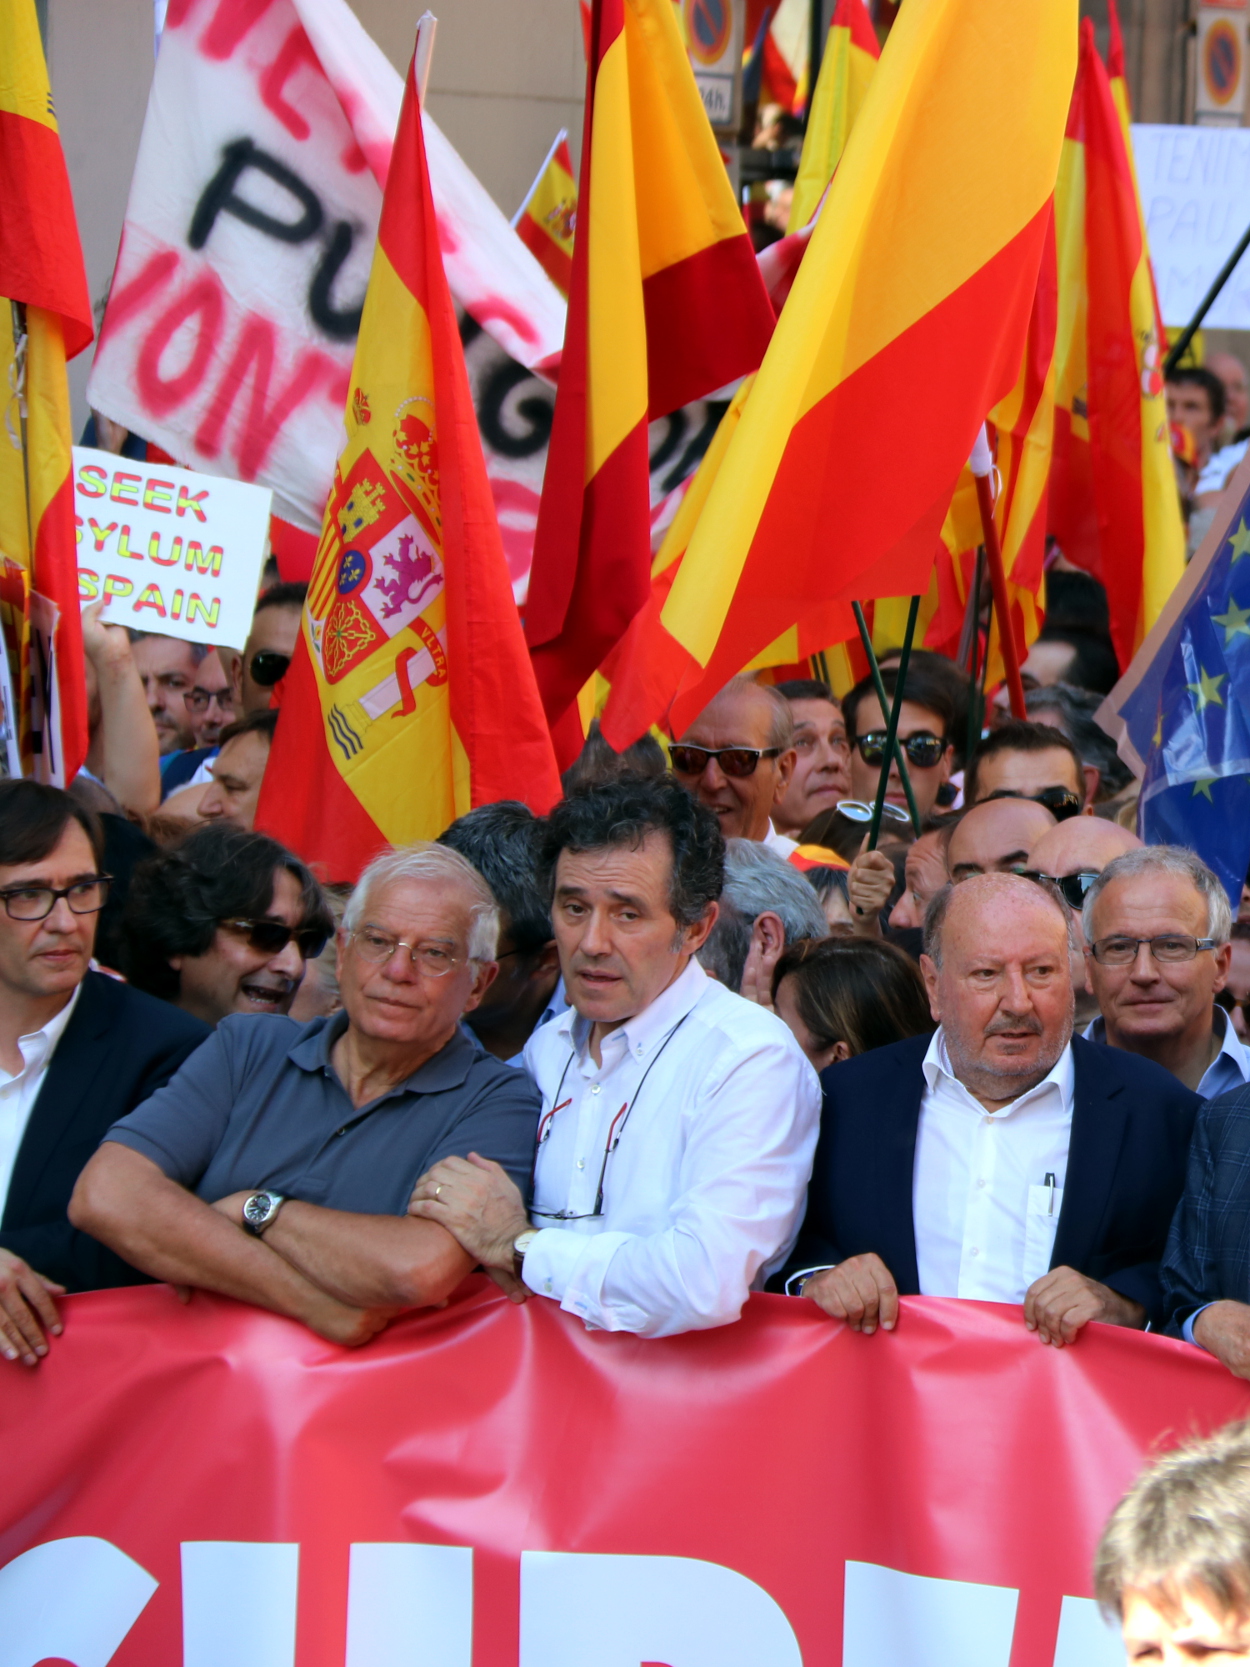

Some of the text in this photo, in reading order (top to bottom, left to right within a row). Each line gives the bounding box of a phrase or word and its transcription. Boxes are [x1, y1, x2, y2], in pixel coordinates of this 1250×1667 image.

[76, 465, 210, 523] SEEK
[78, 567, 221, 628] SPAIN
[421, 626, 447, 678] VLTRA
